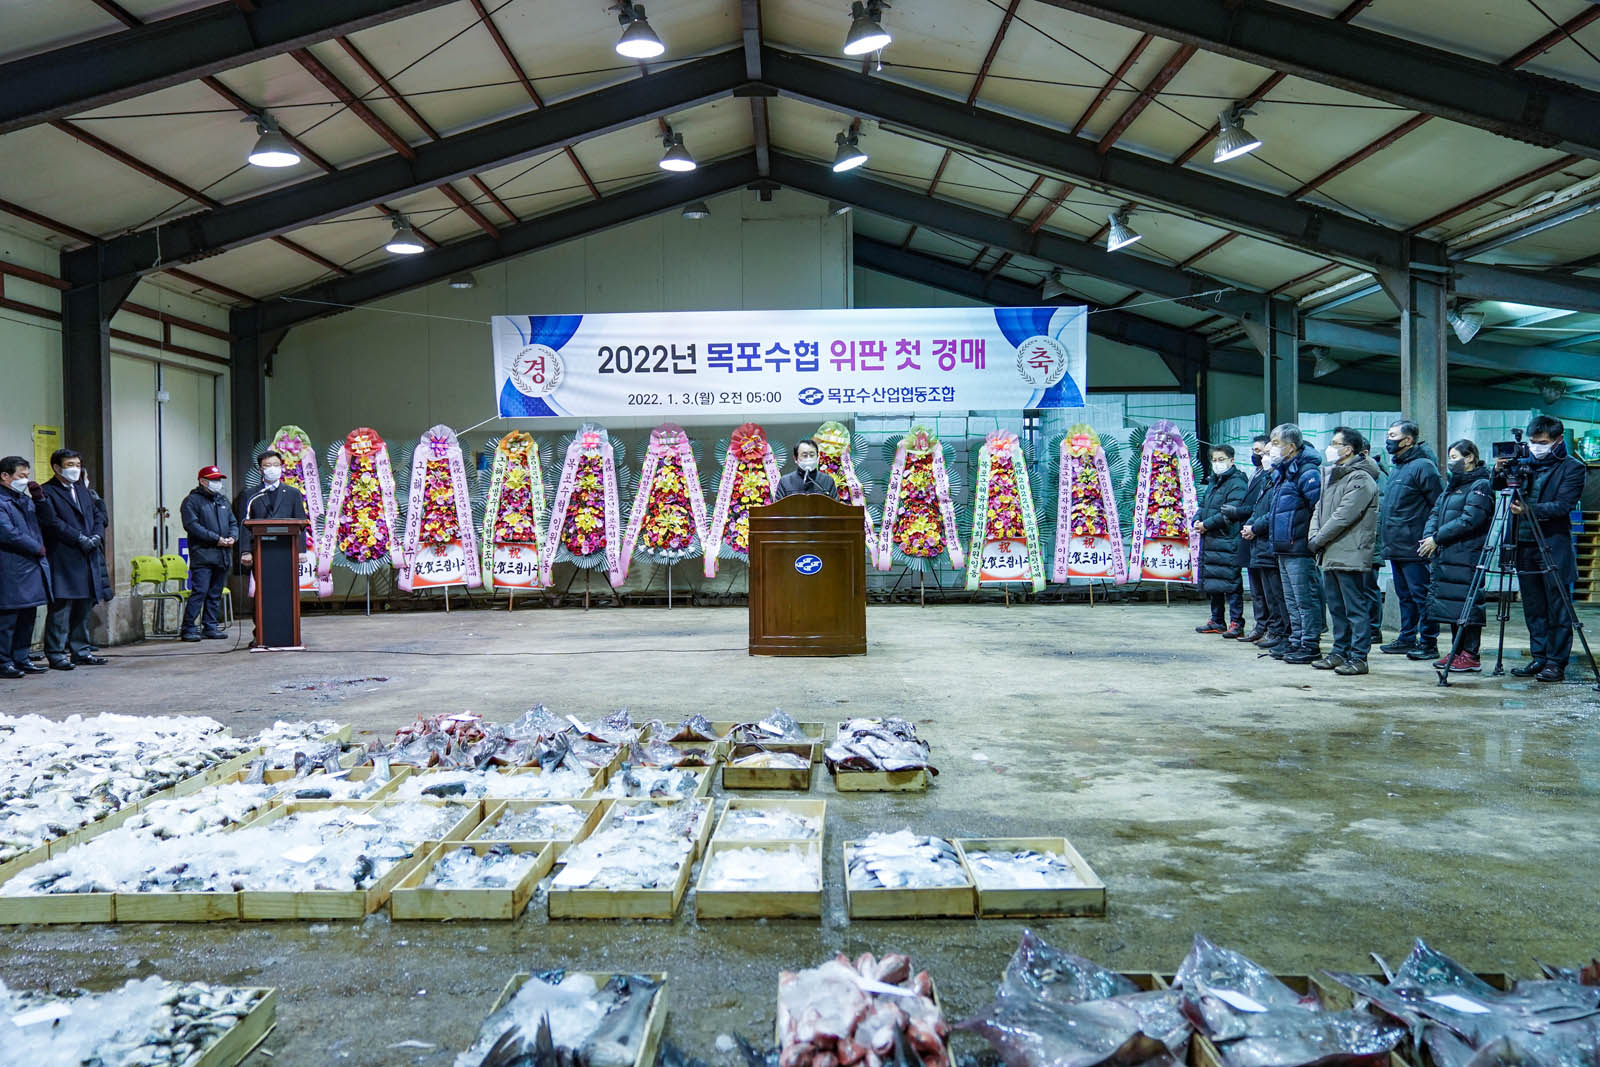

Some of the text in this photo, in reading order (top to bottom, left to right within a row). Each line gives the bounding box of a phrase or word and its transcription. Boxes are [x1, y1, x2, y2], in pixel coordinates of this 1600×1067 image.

[597, 338, 986, 375] 2022년 목포수협 위판 첫 경매
[1026, 346, 1054, 375] 축
[523, 355, 545, 385] 경
[627, 391, 782, 406] 2022. 1. 3.(월) 오전 05:00
[827, 386, 956, 404] 목포수산업협동조합
[556, 458, 577, 514] 목포수협
[1131, 454, 1150, 567] 연안개량안강망협회
[434, 545, 448, 558] 祝
[999, 542, 1012, 554] 祝
[1083, 537, 1096, 550] 祝
[1160, 544, 1174, 557] 祝
[508, 547, 521, 559] 祝
